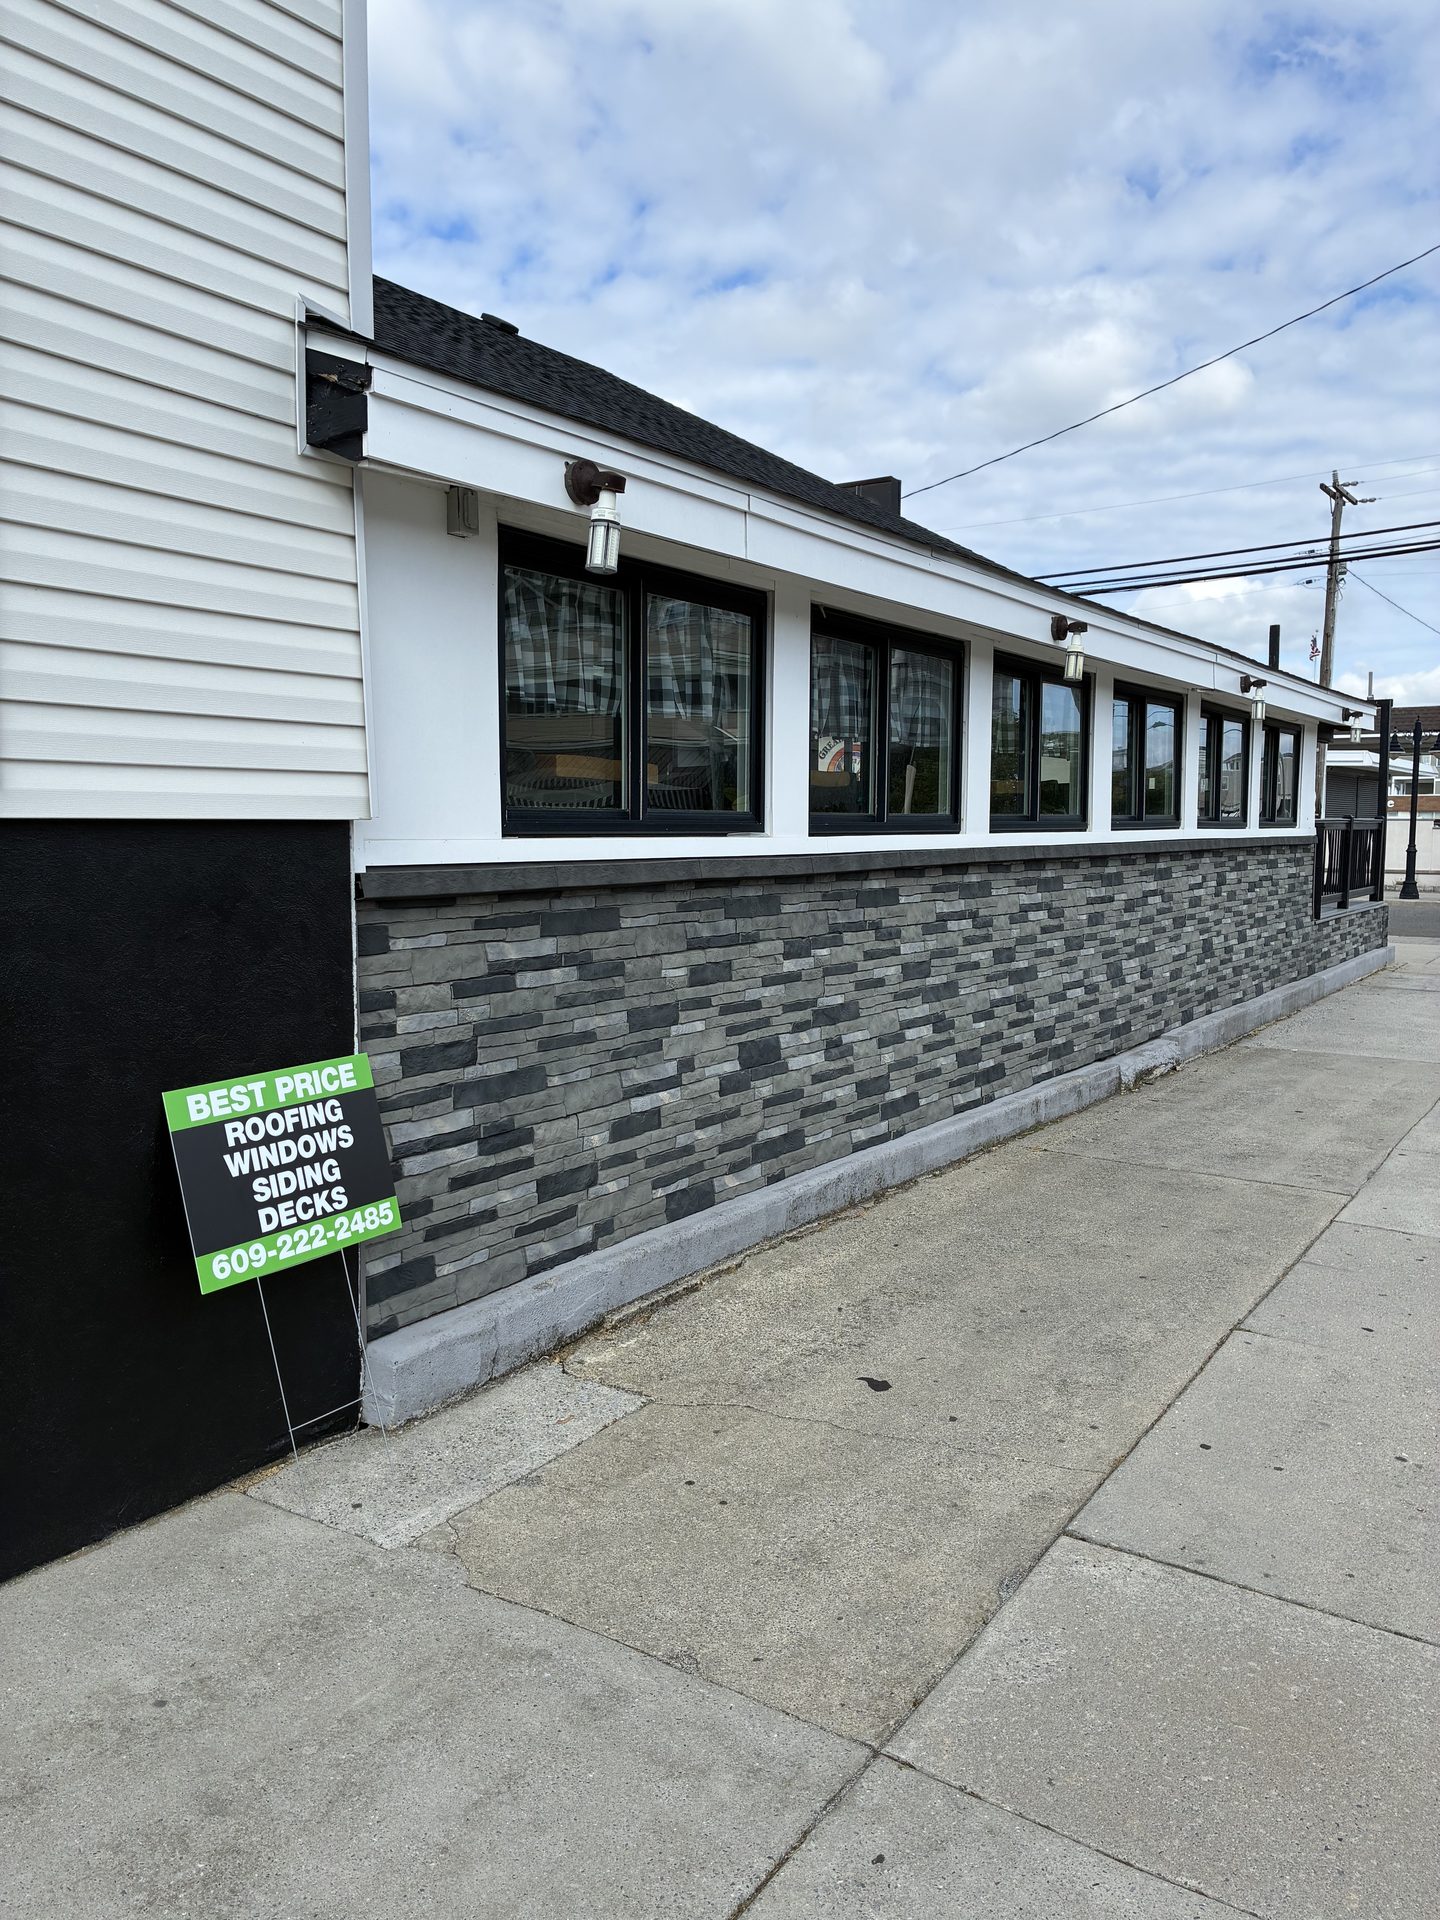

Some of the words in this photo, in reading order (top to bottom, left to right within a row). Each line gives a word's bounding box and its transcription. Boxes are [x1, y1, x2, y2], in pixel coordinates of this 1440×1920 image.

[819, 738, 842, 759] GREA
[186, 1081, 266, 1122] BEST
[274, 1062, 357, 1103] PRICE
[224, 1098, 344, 1148] ROOFING
[223, 1124, 354, 1178] WINDOWS
[252, 1158, 341, 1203] SIDING
[257, 1186, 349, 1233] DECKS
[211, 1201, 394, 1280] 609-222-2485
